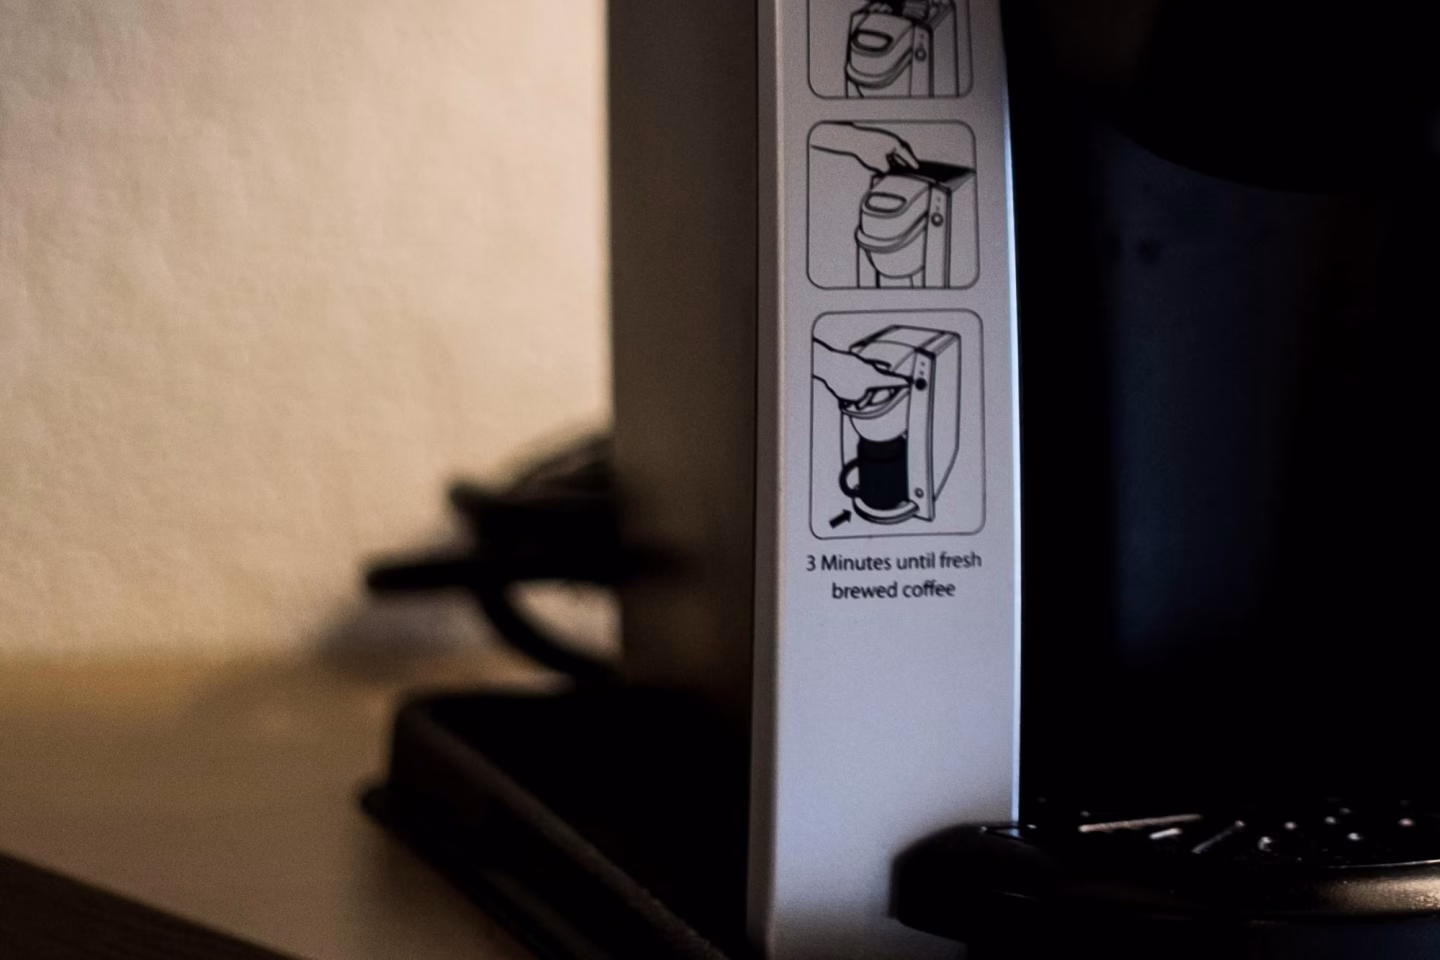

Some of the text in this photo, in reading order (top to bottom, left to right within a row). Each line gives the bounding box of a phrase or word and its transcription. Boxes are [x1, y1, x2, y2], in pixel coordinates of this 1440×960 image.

[805, 550, 983, 572] 3 Minutes until fresh
[831, 578, 957, 599] brewed coffee
